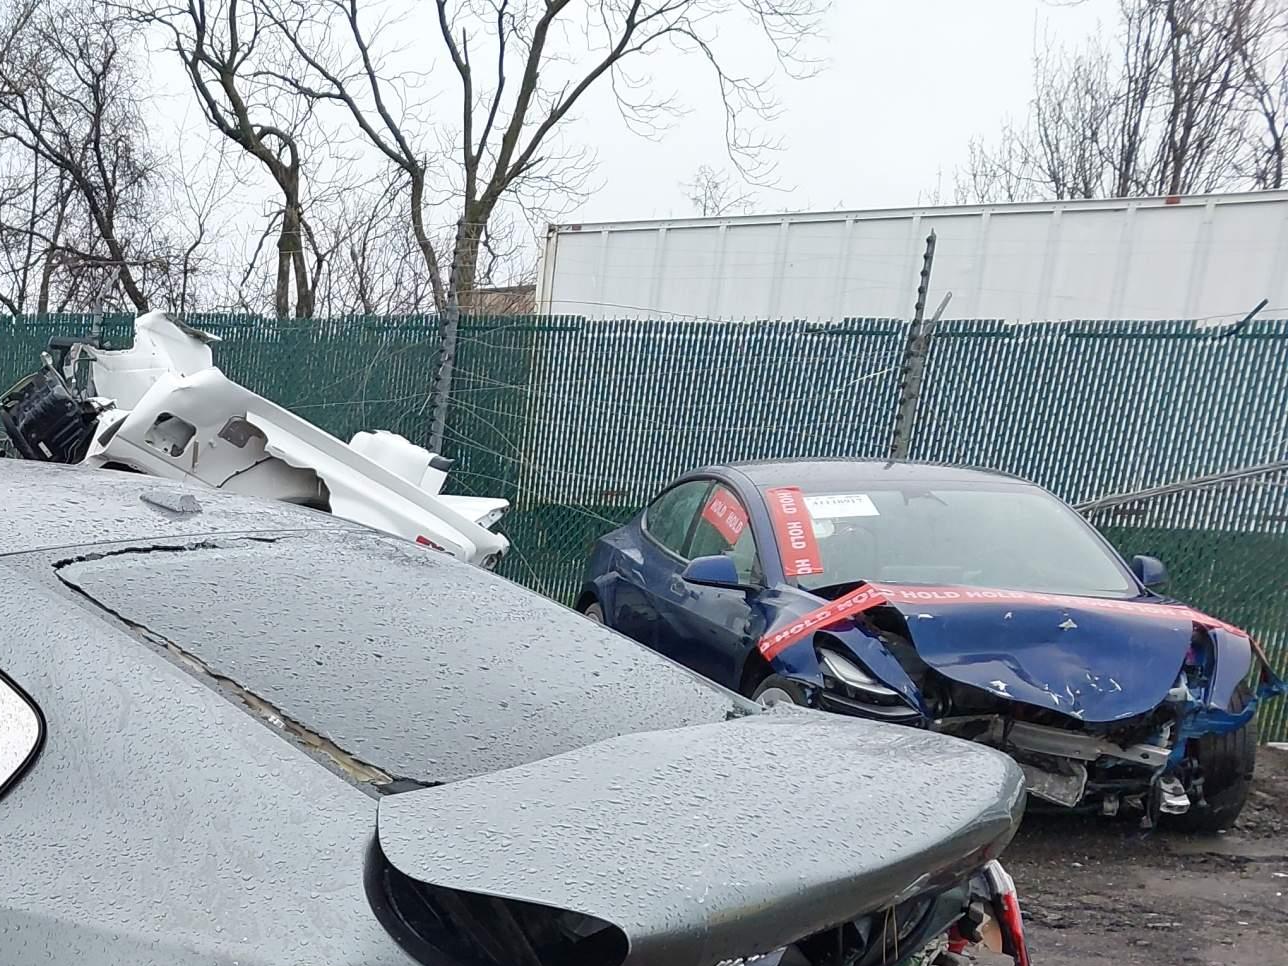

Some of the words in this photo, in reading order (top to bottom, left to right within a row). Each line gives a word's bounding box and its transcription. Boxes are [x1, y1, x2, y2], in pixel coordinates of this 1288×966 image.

[777, 491, 796, 514] HOLD
[787, 521, 806, 549] HOLD
[902, 590, 962, 599] HOLD
[775, 609, 832, 644] HOLD
